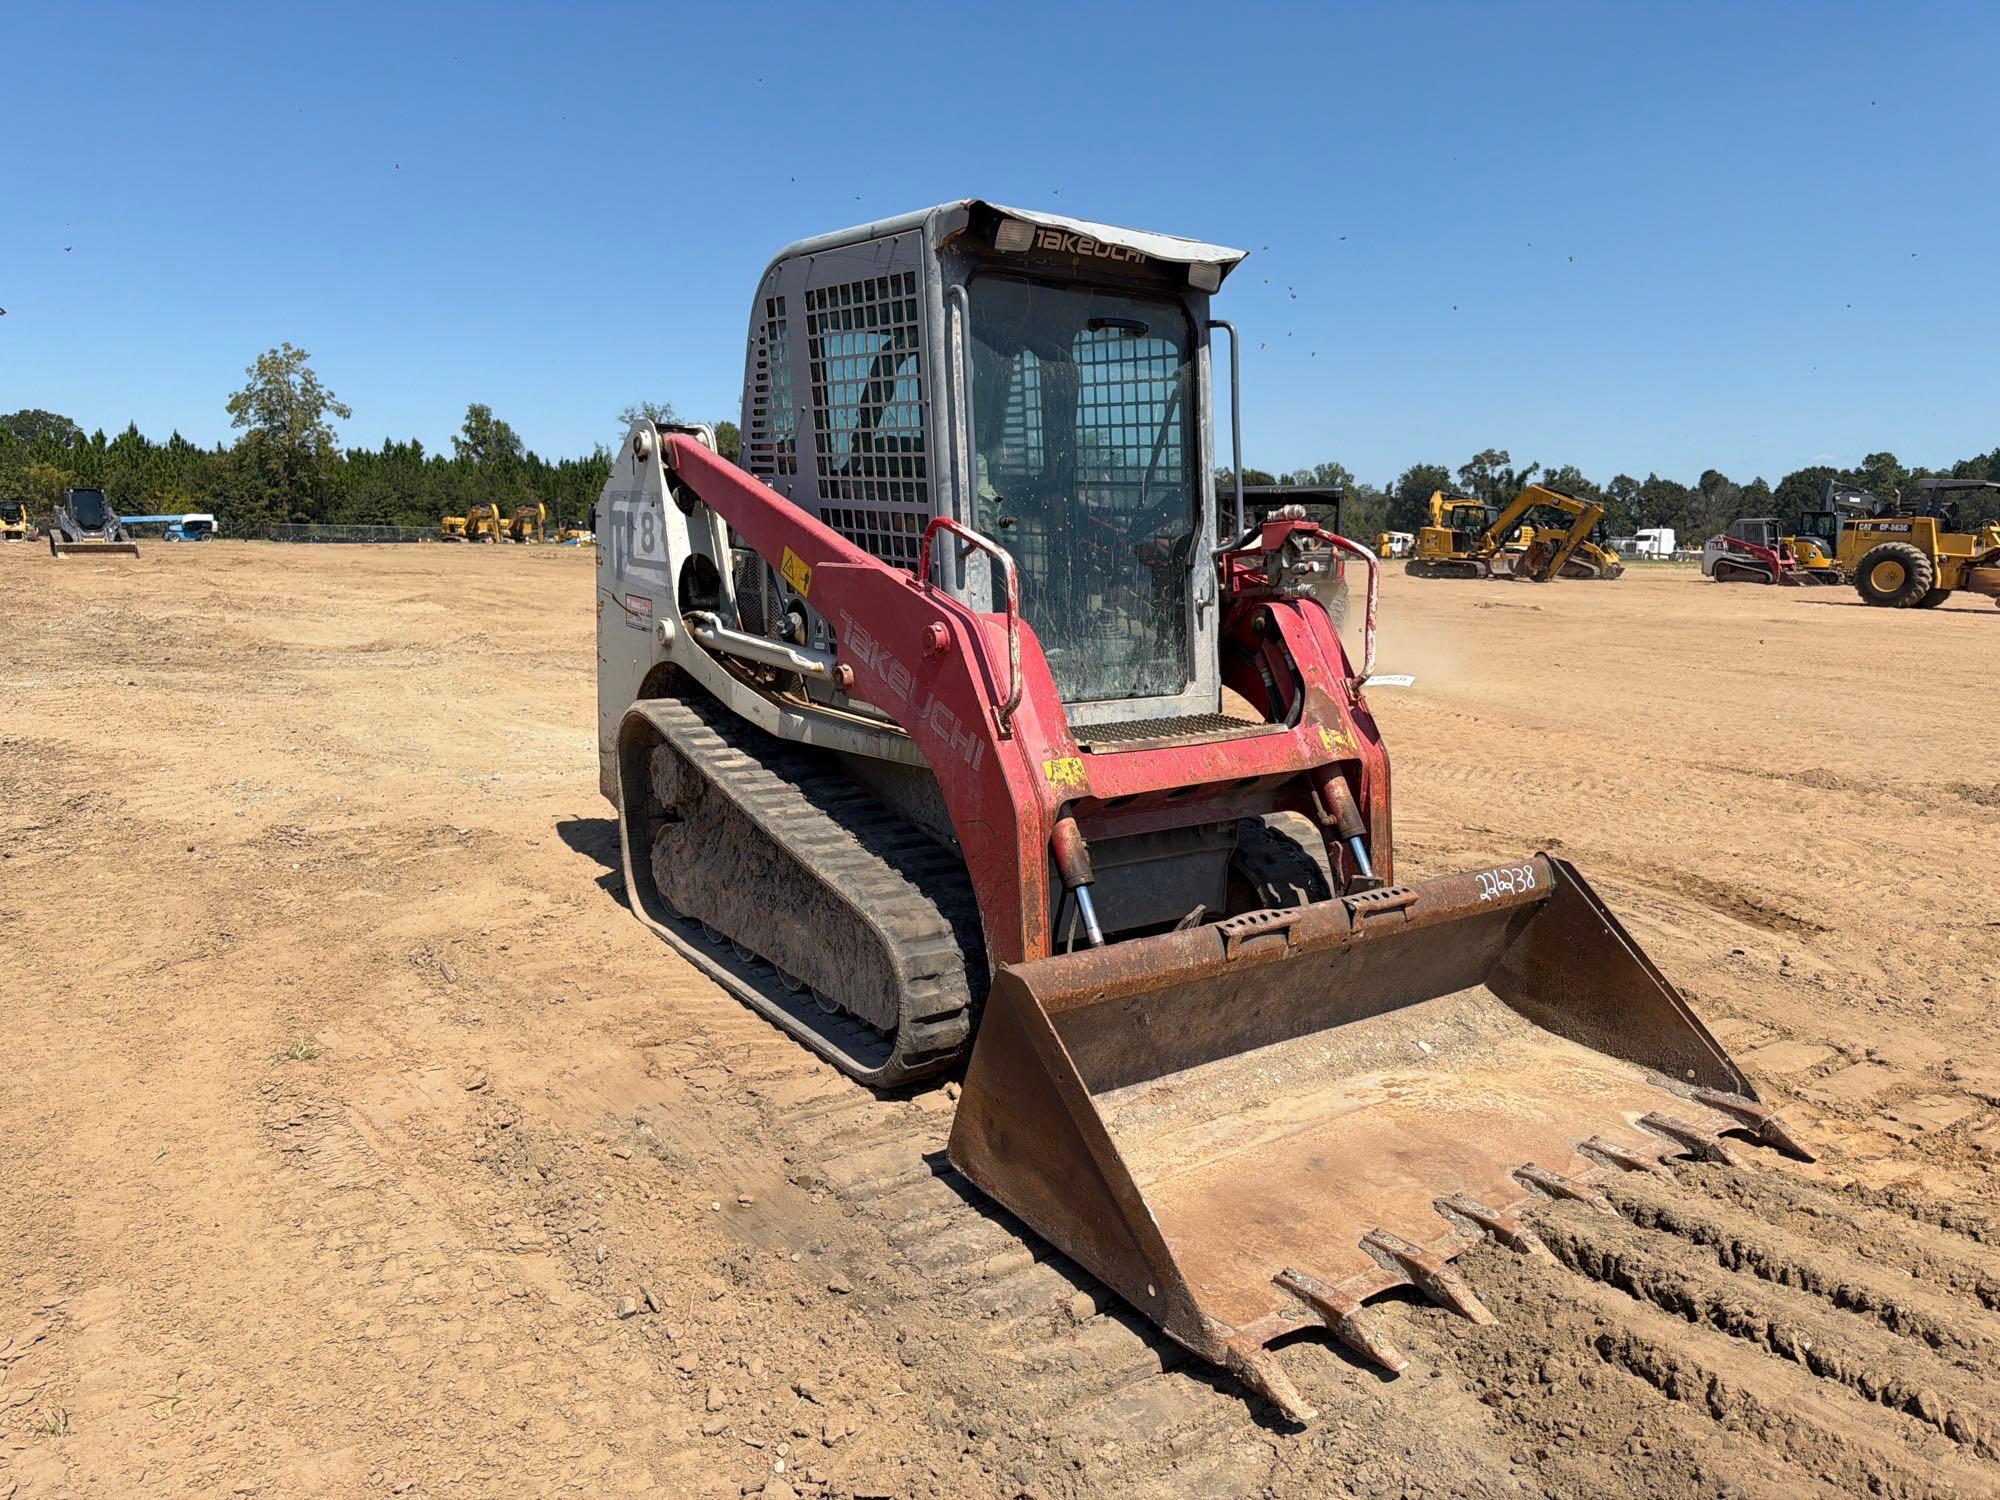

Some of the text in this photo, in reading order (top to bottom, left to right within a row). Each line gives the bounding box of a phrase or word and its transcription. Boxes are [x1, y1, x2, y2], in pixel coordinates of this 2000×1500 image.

[1858, 523, 1872, 531] CAT
[840, 608, 985, 771] TAKEUCHI
[1475, 865, 1535, 901] 226238
